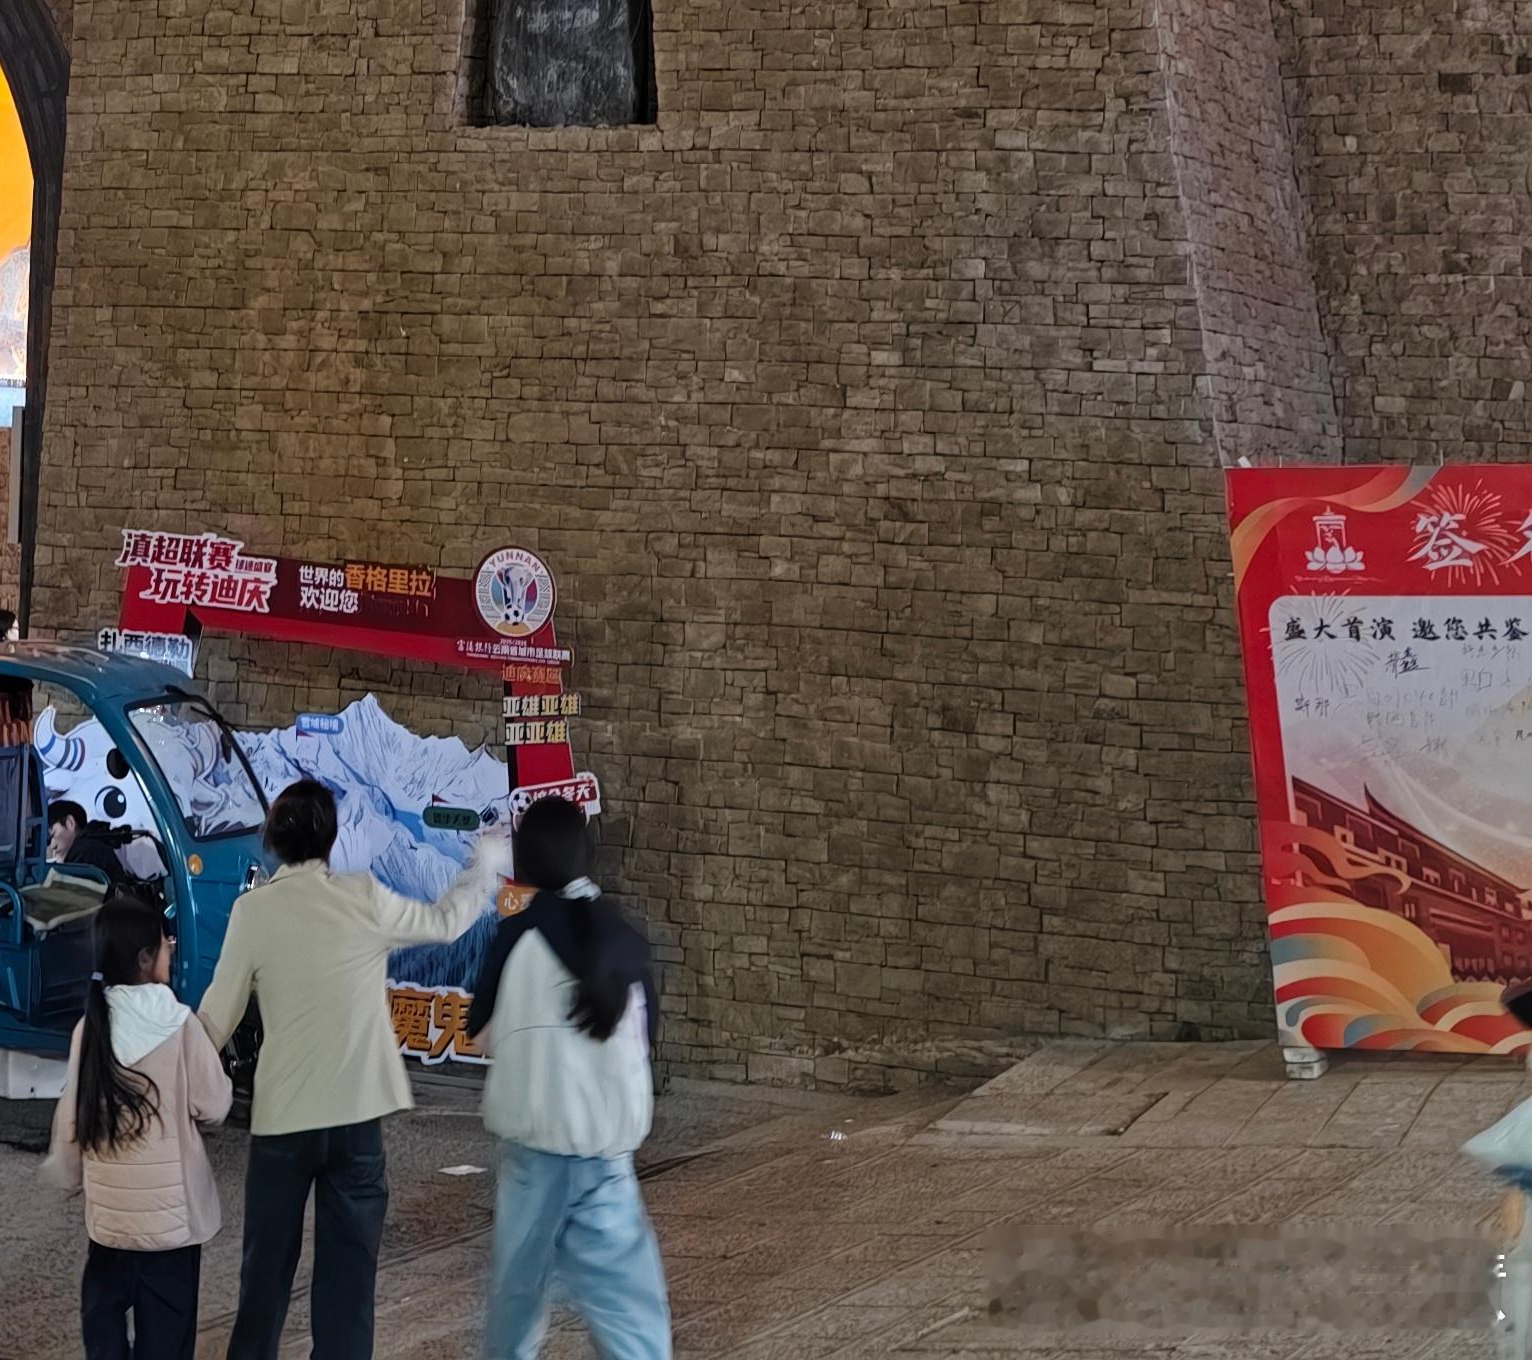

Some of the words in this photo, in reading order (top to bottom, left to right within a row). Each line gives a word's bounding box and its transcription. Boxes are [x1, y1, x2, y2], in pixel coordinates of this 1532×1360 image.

[119, 531, 240, 572] 滇超联赛
[488, 551, 541, 572] YUNNAN
[149, 568, 272, 611] 玩转迪庆
[300, 586, 359, 614] 欢迎您
[1283, 617, 1396, 642] 盛大首演
[1411, 617, 1530, 642] 邀您共鉴
[100, 631, 191, 661] 扎西德勒
[503, 693, 579, 717] 亚雄亚雄
[505, 720, 567, 745] 亚亚雄
